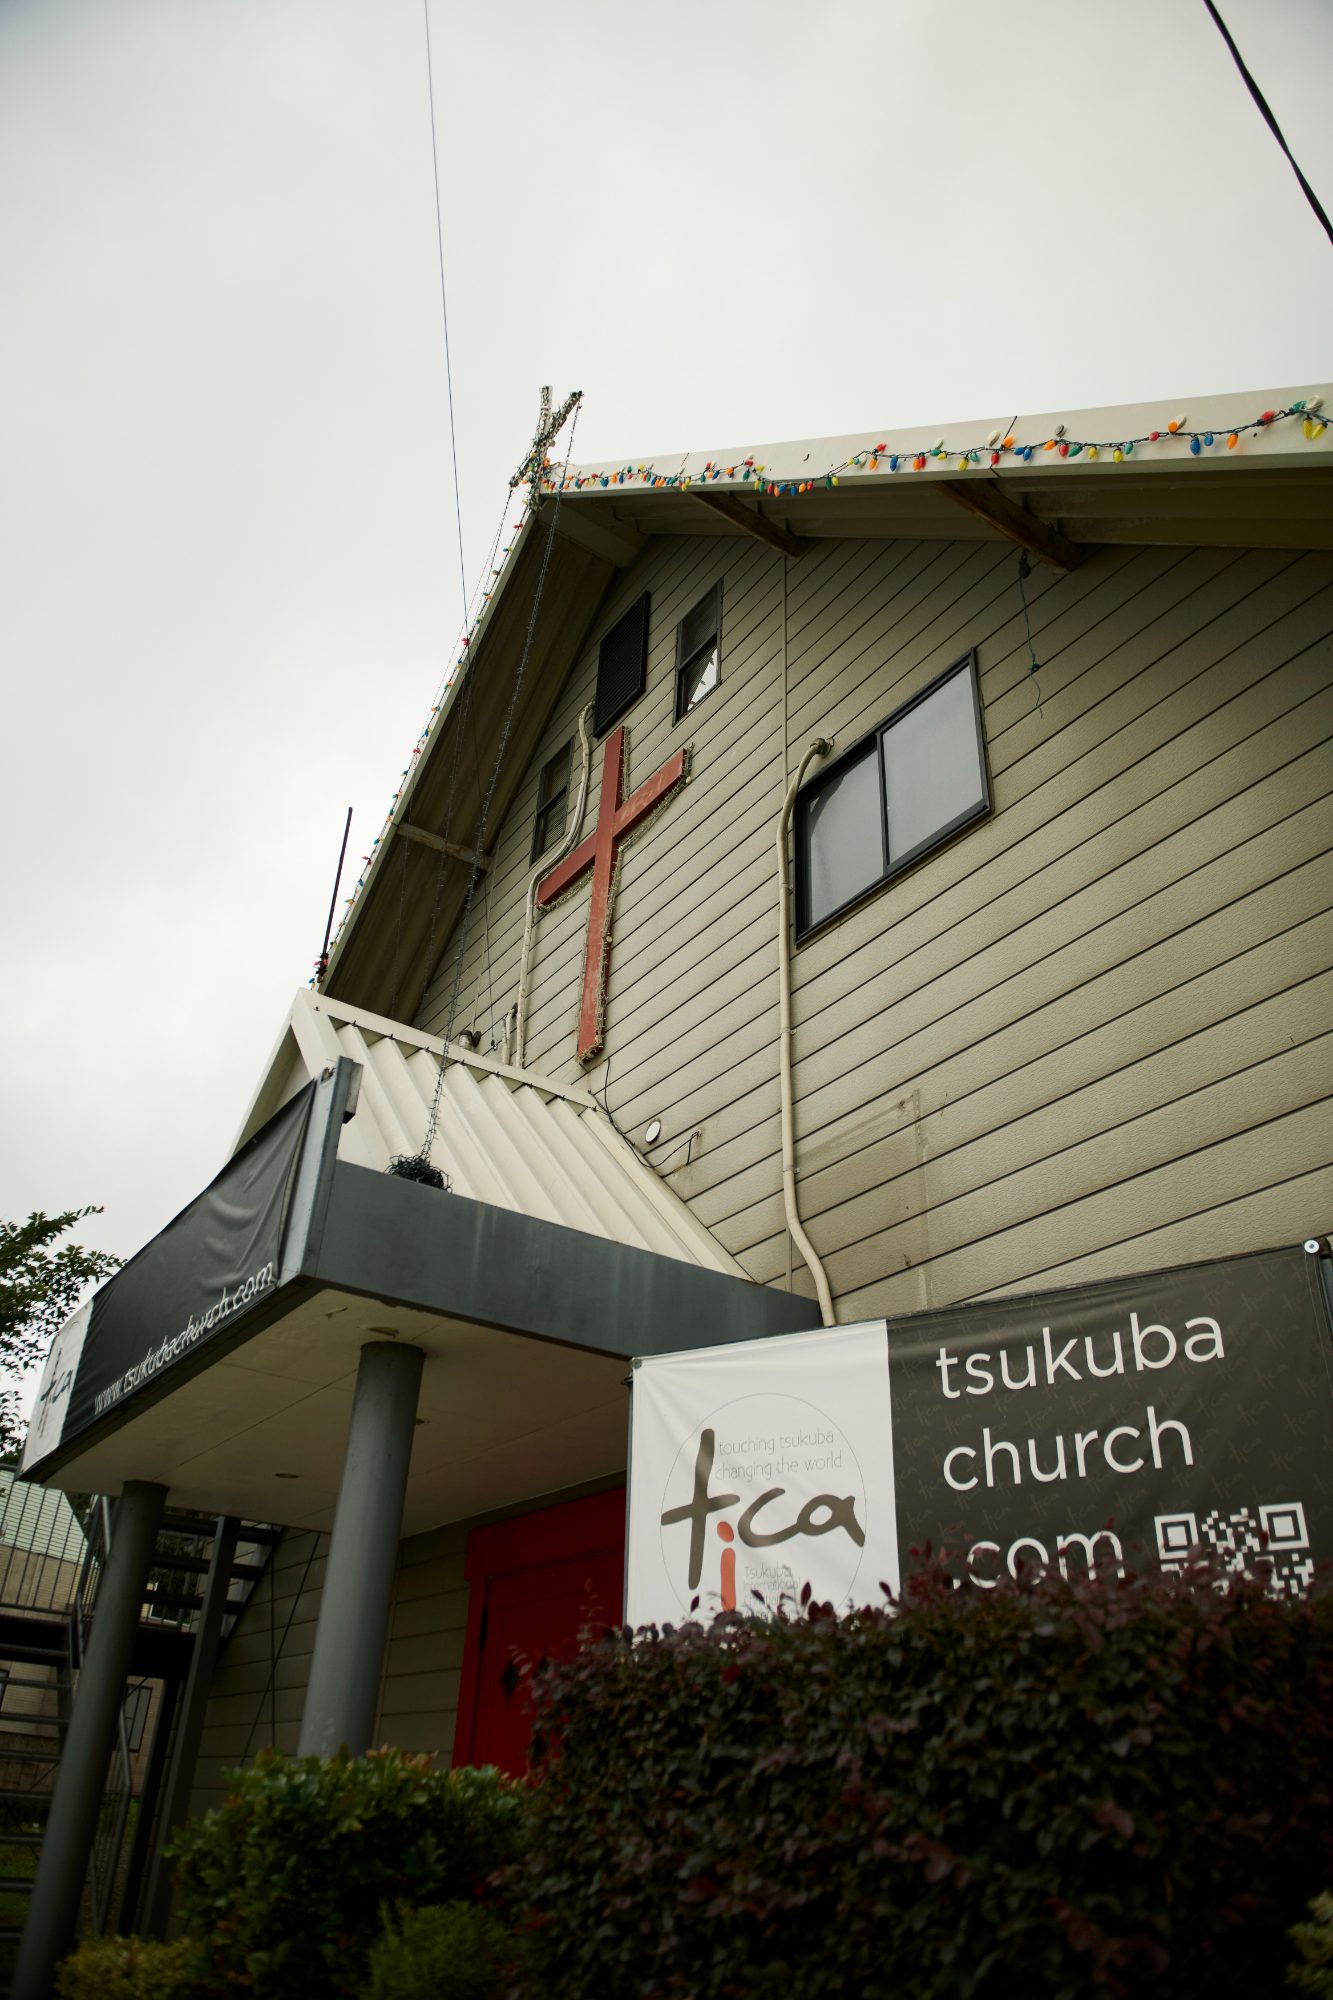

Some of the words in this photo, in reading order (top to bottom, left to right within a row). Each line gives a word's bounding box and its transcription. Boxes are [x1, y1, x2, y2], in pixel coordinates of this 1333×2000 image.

[94, 1261, 274, 1416] www.tsukubachurch.com
[935, 1311, 1226, 1400] tsukuba
[714, 1463, 772, 1482] changing
[776, 1456, 799, 1474] the
[804, 1449, 843, 1472] world
[719, 1434, 775, 1456] touching
[779, 1428, 835, 1449] tsukuba
[942, 1405, 1195, 1492] church
[952, 1530, 1126, 1590] .com
